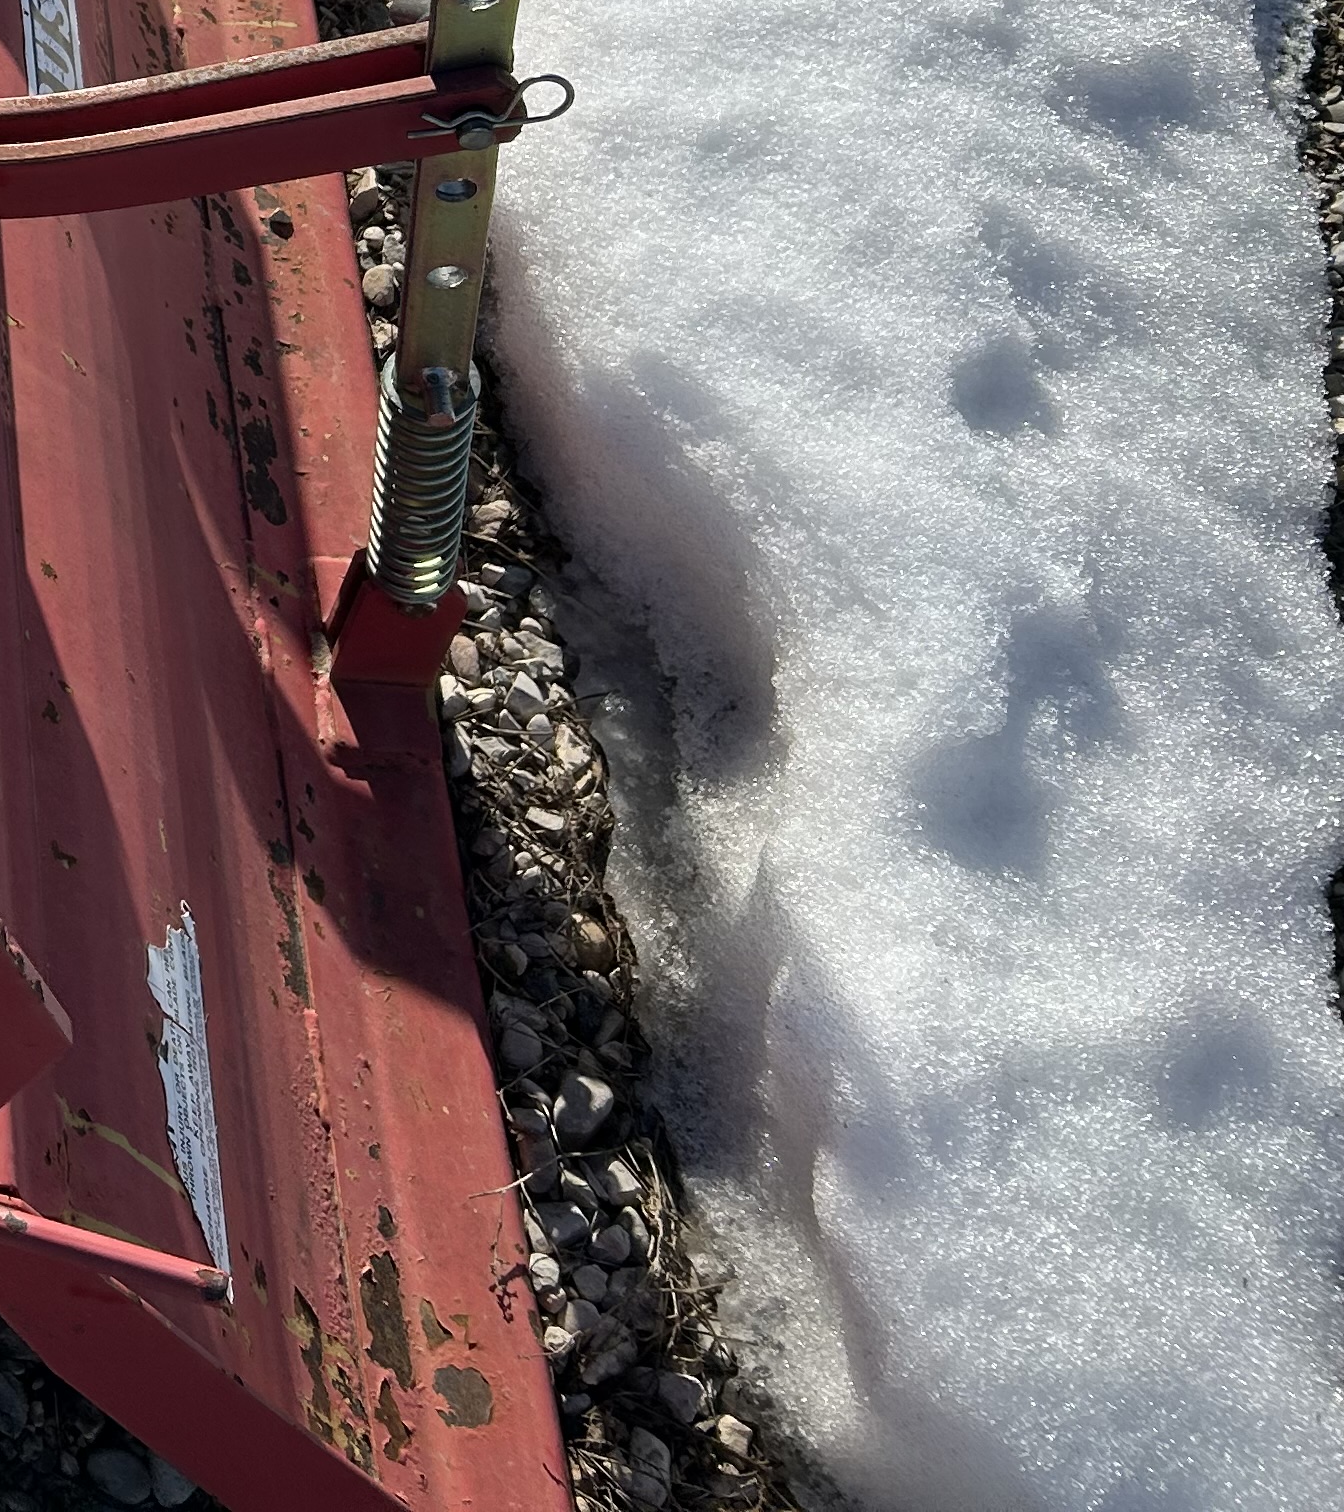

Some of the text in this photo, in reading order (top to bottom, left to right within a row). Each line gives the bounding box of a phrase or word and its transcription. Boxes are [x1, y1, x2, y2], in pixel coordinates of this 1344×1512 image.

[175, 1072, 181, 1094] OR
[185, 1038, 199, 1139] KEEP AWAY
[177, 1102, 186, 1154] INJURY
[186, 1137, 196, 1200] THROWN
